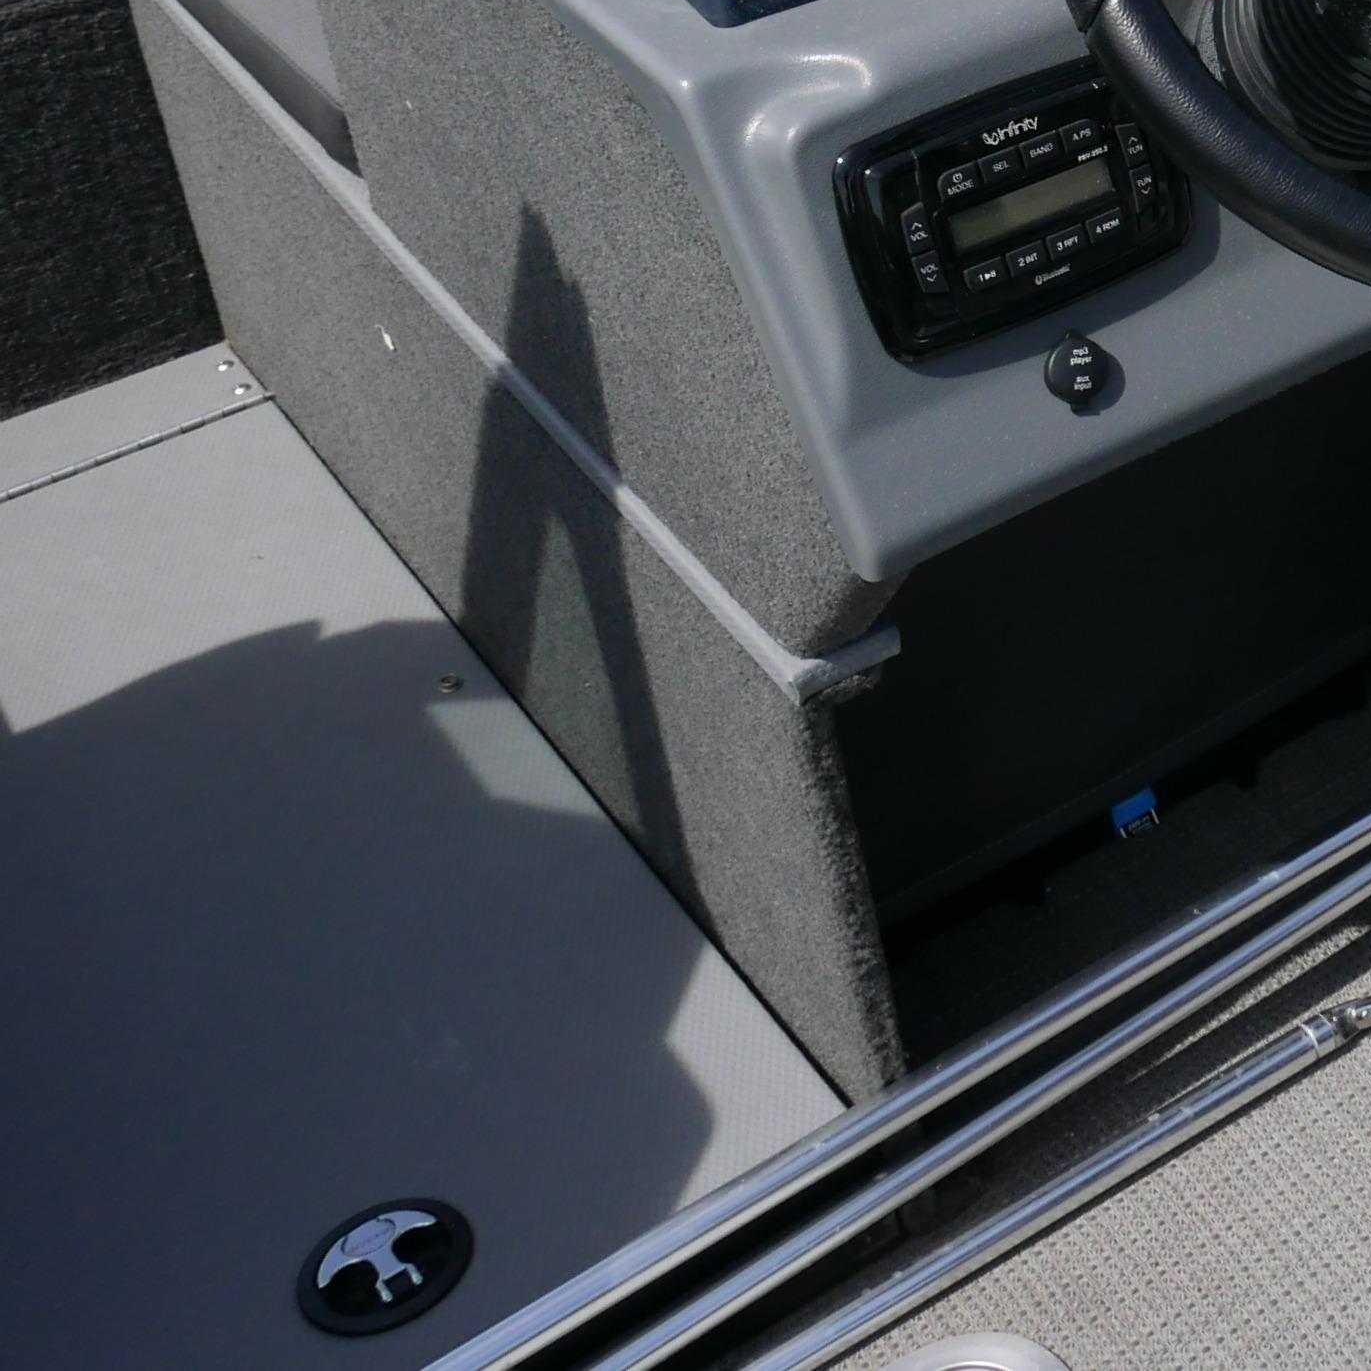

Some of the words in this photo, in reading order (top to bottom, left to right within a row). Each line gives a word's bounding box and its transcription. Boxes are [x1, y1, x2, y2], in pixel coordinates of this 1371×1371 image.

[1030, 142, 1054, 159] BAND
[992, 161, 1011, 173] SEL
[947, 179, 975, 196] MODE
[910, 230, 929, 242] VOL
[1056, 241, 1064, 251] 3
[919, 262, 939, 275] VOL
[1018, 257, 1026, 268] 2
[1072, 346, 1089, 358] mp3
[1070, 354, 1093, 366] player
[1073, 381, 1092, 392] input
